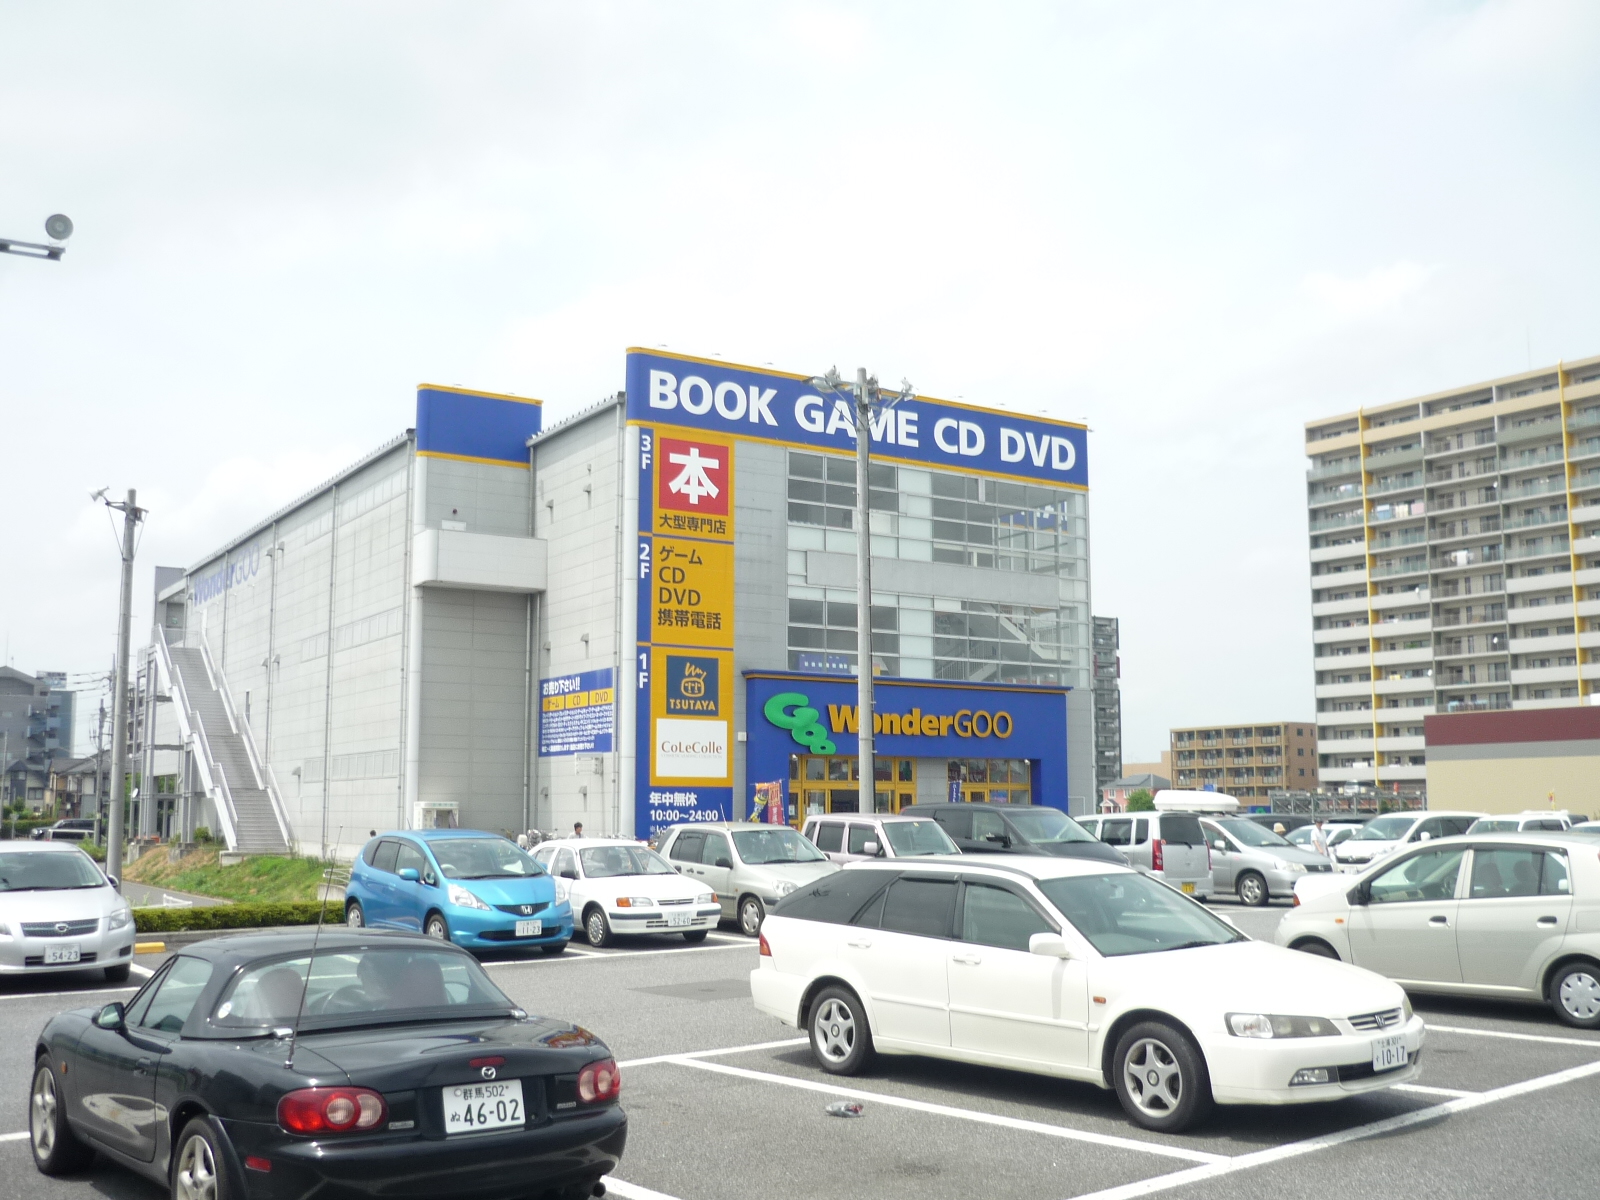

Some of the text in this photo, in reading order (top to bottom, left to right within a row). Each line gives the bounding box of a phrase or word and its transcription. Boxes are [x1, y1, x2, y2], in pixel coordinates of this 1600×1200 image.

[649, 369, 1076, 471] BOOK GAME CD DVD
[668, 446, 720, 505] 本
[659, 513, 727, 535] 大型専門店
[659, 545, 703, 566] ゲーム
[658, 566, 686, 584] CD
[659, 586, 702, 607] DVD
[657, 608, 722, 631] 携帯電話
[572, 695, 581, 706] CD
[594, 691, 609, 703] DVD
[669, 698, 716, 711] TSUTAYA
[649, 791, 698, 807] 年中無休
[52, 950, 79, 961] 54-23
[463, 1085, 505, 1100] 群馬 502
[464, 1098, 520, 1126] 46-02
